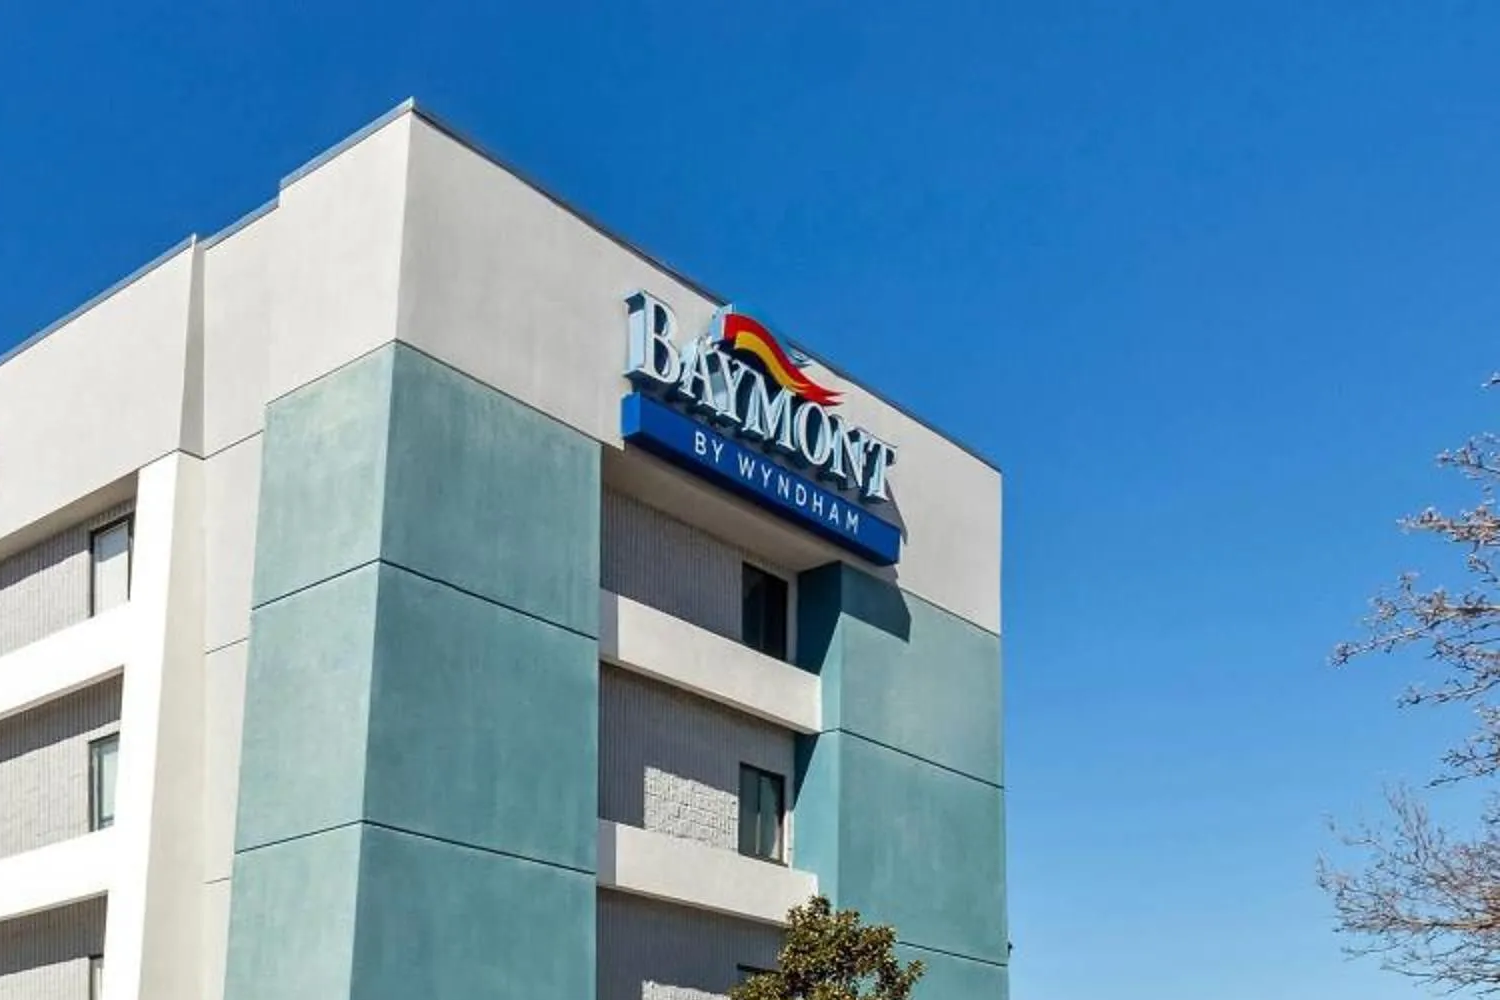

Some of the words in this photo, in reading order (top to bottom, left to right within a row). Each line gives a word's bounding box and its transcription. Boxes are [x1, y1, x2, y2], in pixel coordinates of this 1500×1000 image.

[623, 289, 898, 501] BAYMONT
[694, 431, 724, 464] BY
[737, 452, 860, 535] WYNDHAM
